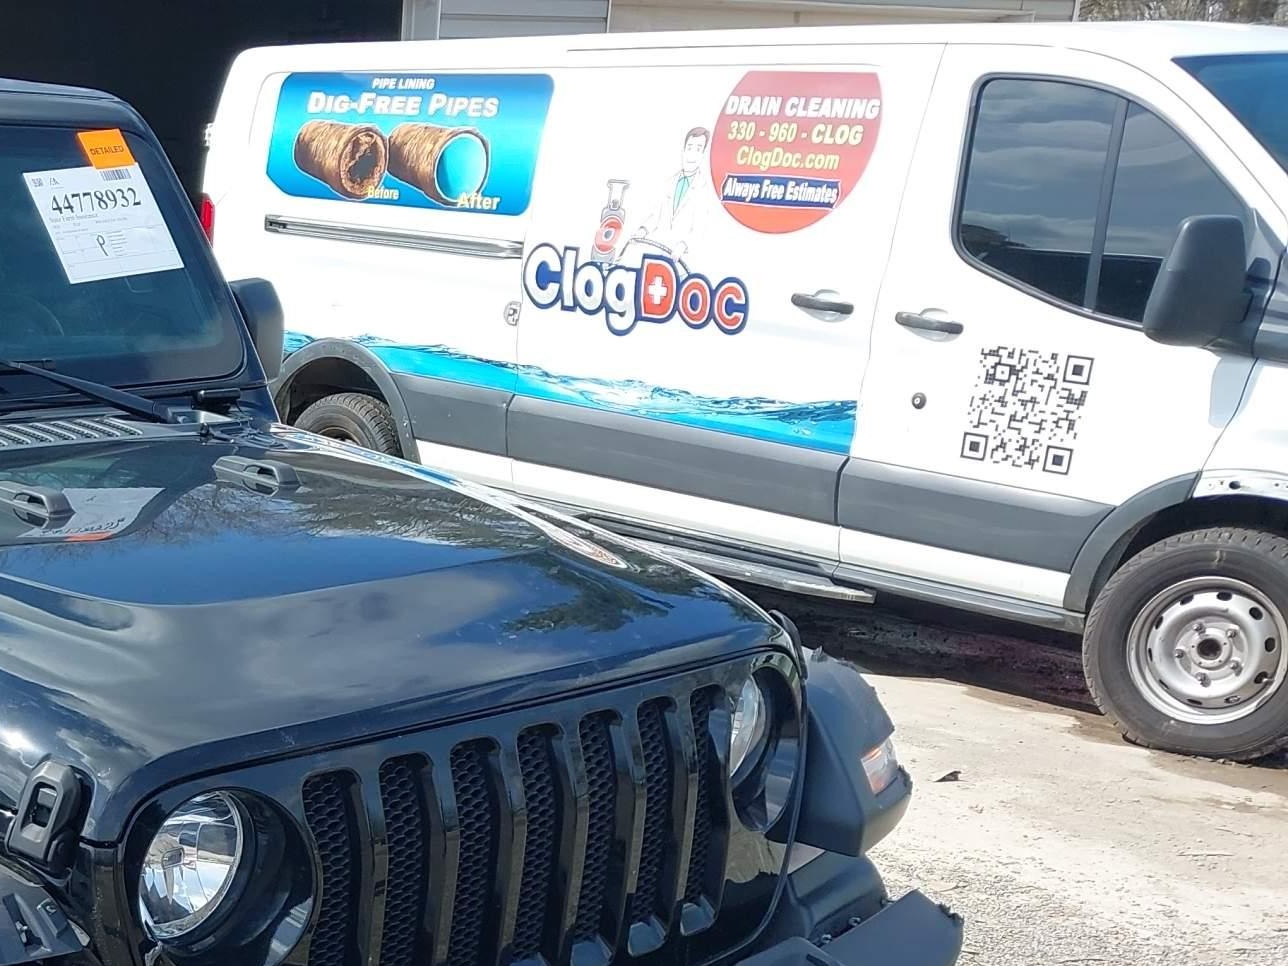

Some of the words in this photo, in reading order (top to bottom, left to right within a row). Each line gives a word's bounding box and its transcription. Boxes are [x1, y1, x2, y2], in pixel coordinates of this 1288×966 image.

[372, 78, 397, 90] PIPE
[398, 79, 435, 90] LINING
[725, 95, 782, 117] DRAIN
[785, 96, 881, 120] CLEANING
[728, 120, 755, 141] 330
[768, 122, 797, 143] 960
[811, 124, 864, 145] CLOG
[89, 145, 124, 156] DETAILED
[736, 145, 840, 171] ClogDoc.com
[51, 187, 142, 215] 44778932
[367, 186, 399, 200] Before
[457, 192, 500, 211] After
[723, 176, 760, 202] Always
[760, 179, 785, 200] Free
[785, 181, 838, 204] Estimates
[523, 242, 750, 336] ClogDoc
